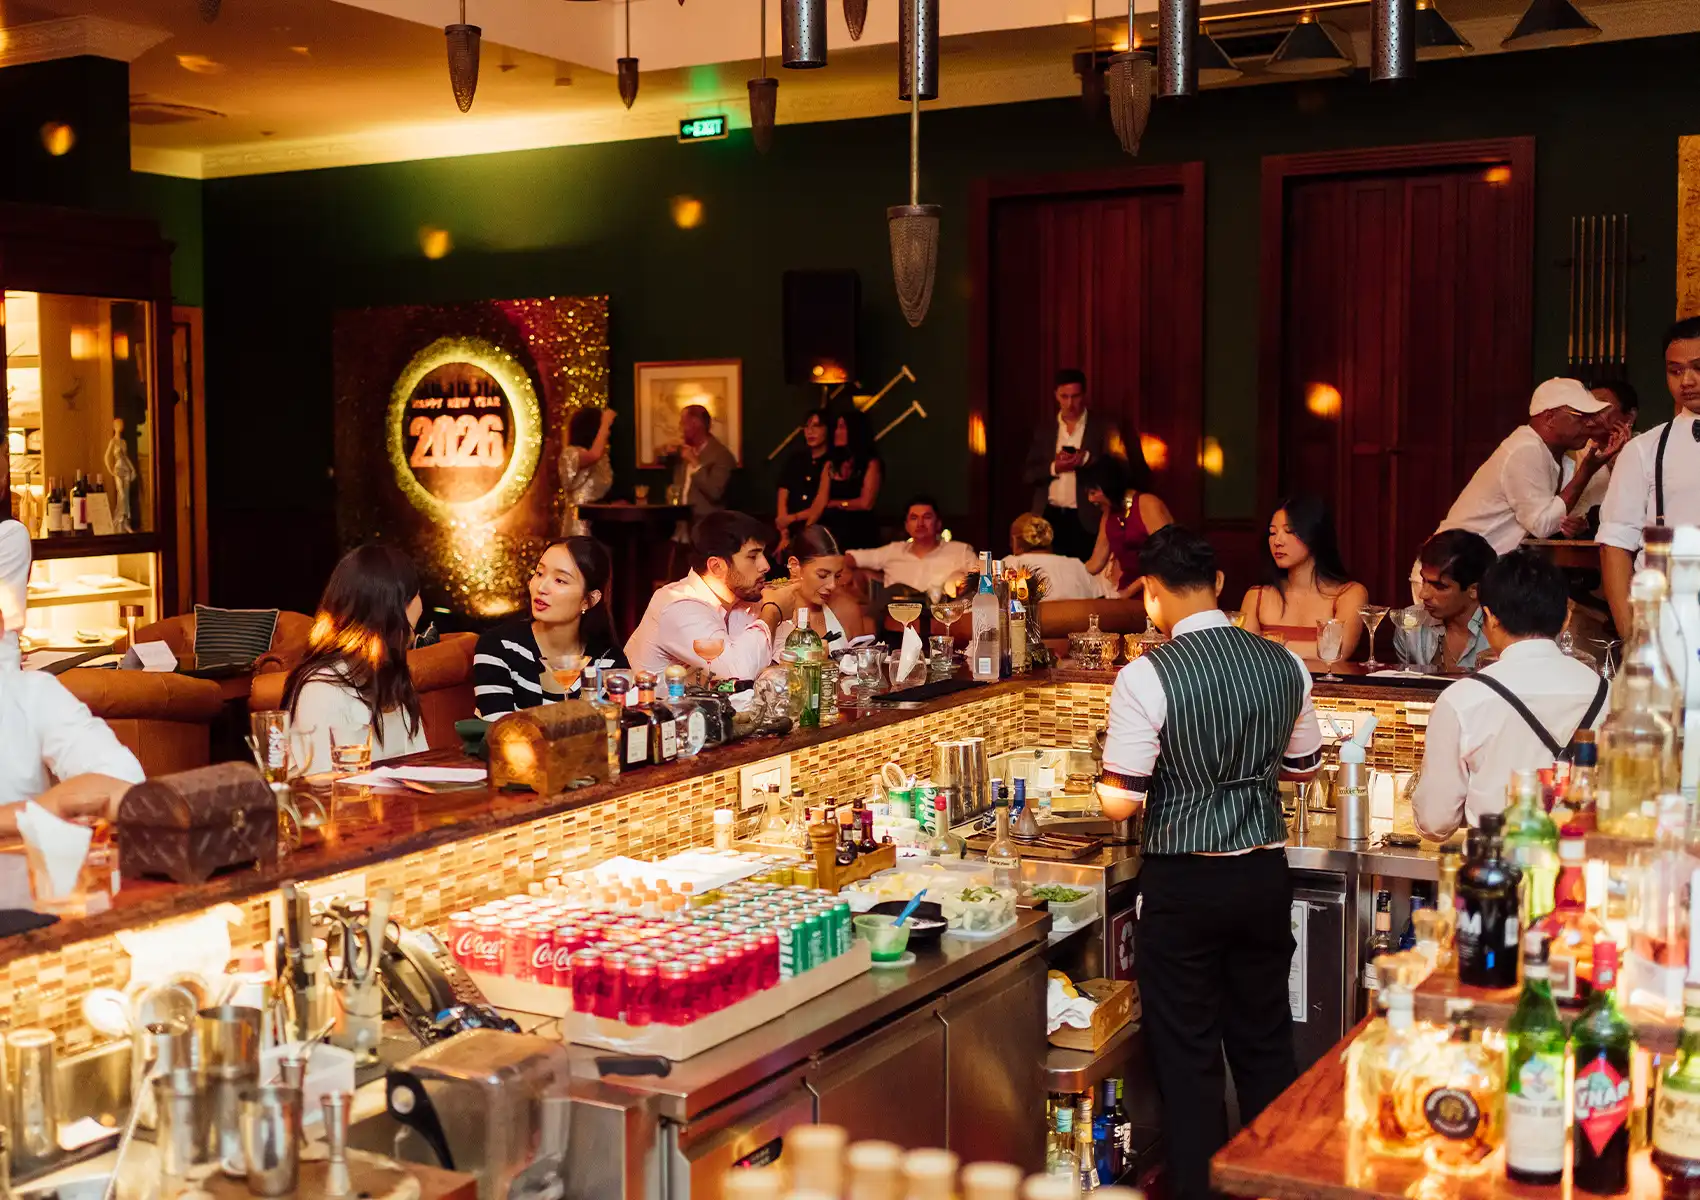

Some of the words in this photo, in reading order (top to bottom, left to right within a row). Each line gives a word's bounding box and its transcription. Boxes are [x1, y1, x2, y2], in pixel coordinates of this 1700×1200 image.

[693, 118, 723, 137] EXIT
[412, 398, 443, 409] HAPPY
[446, 397, 470, 409] NEW
[473, 396, 501, 408] YEAR
[409, 414, 504, 468] 2026
